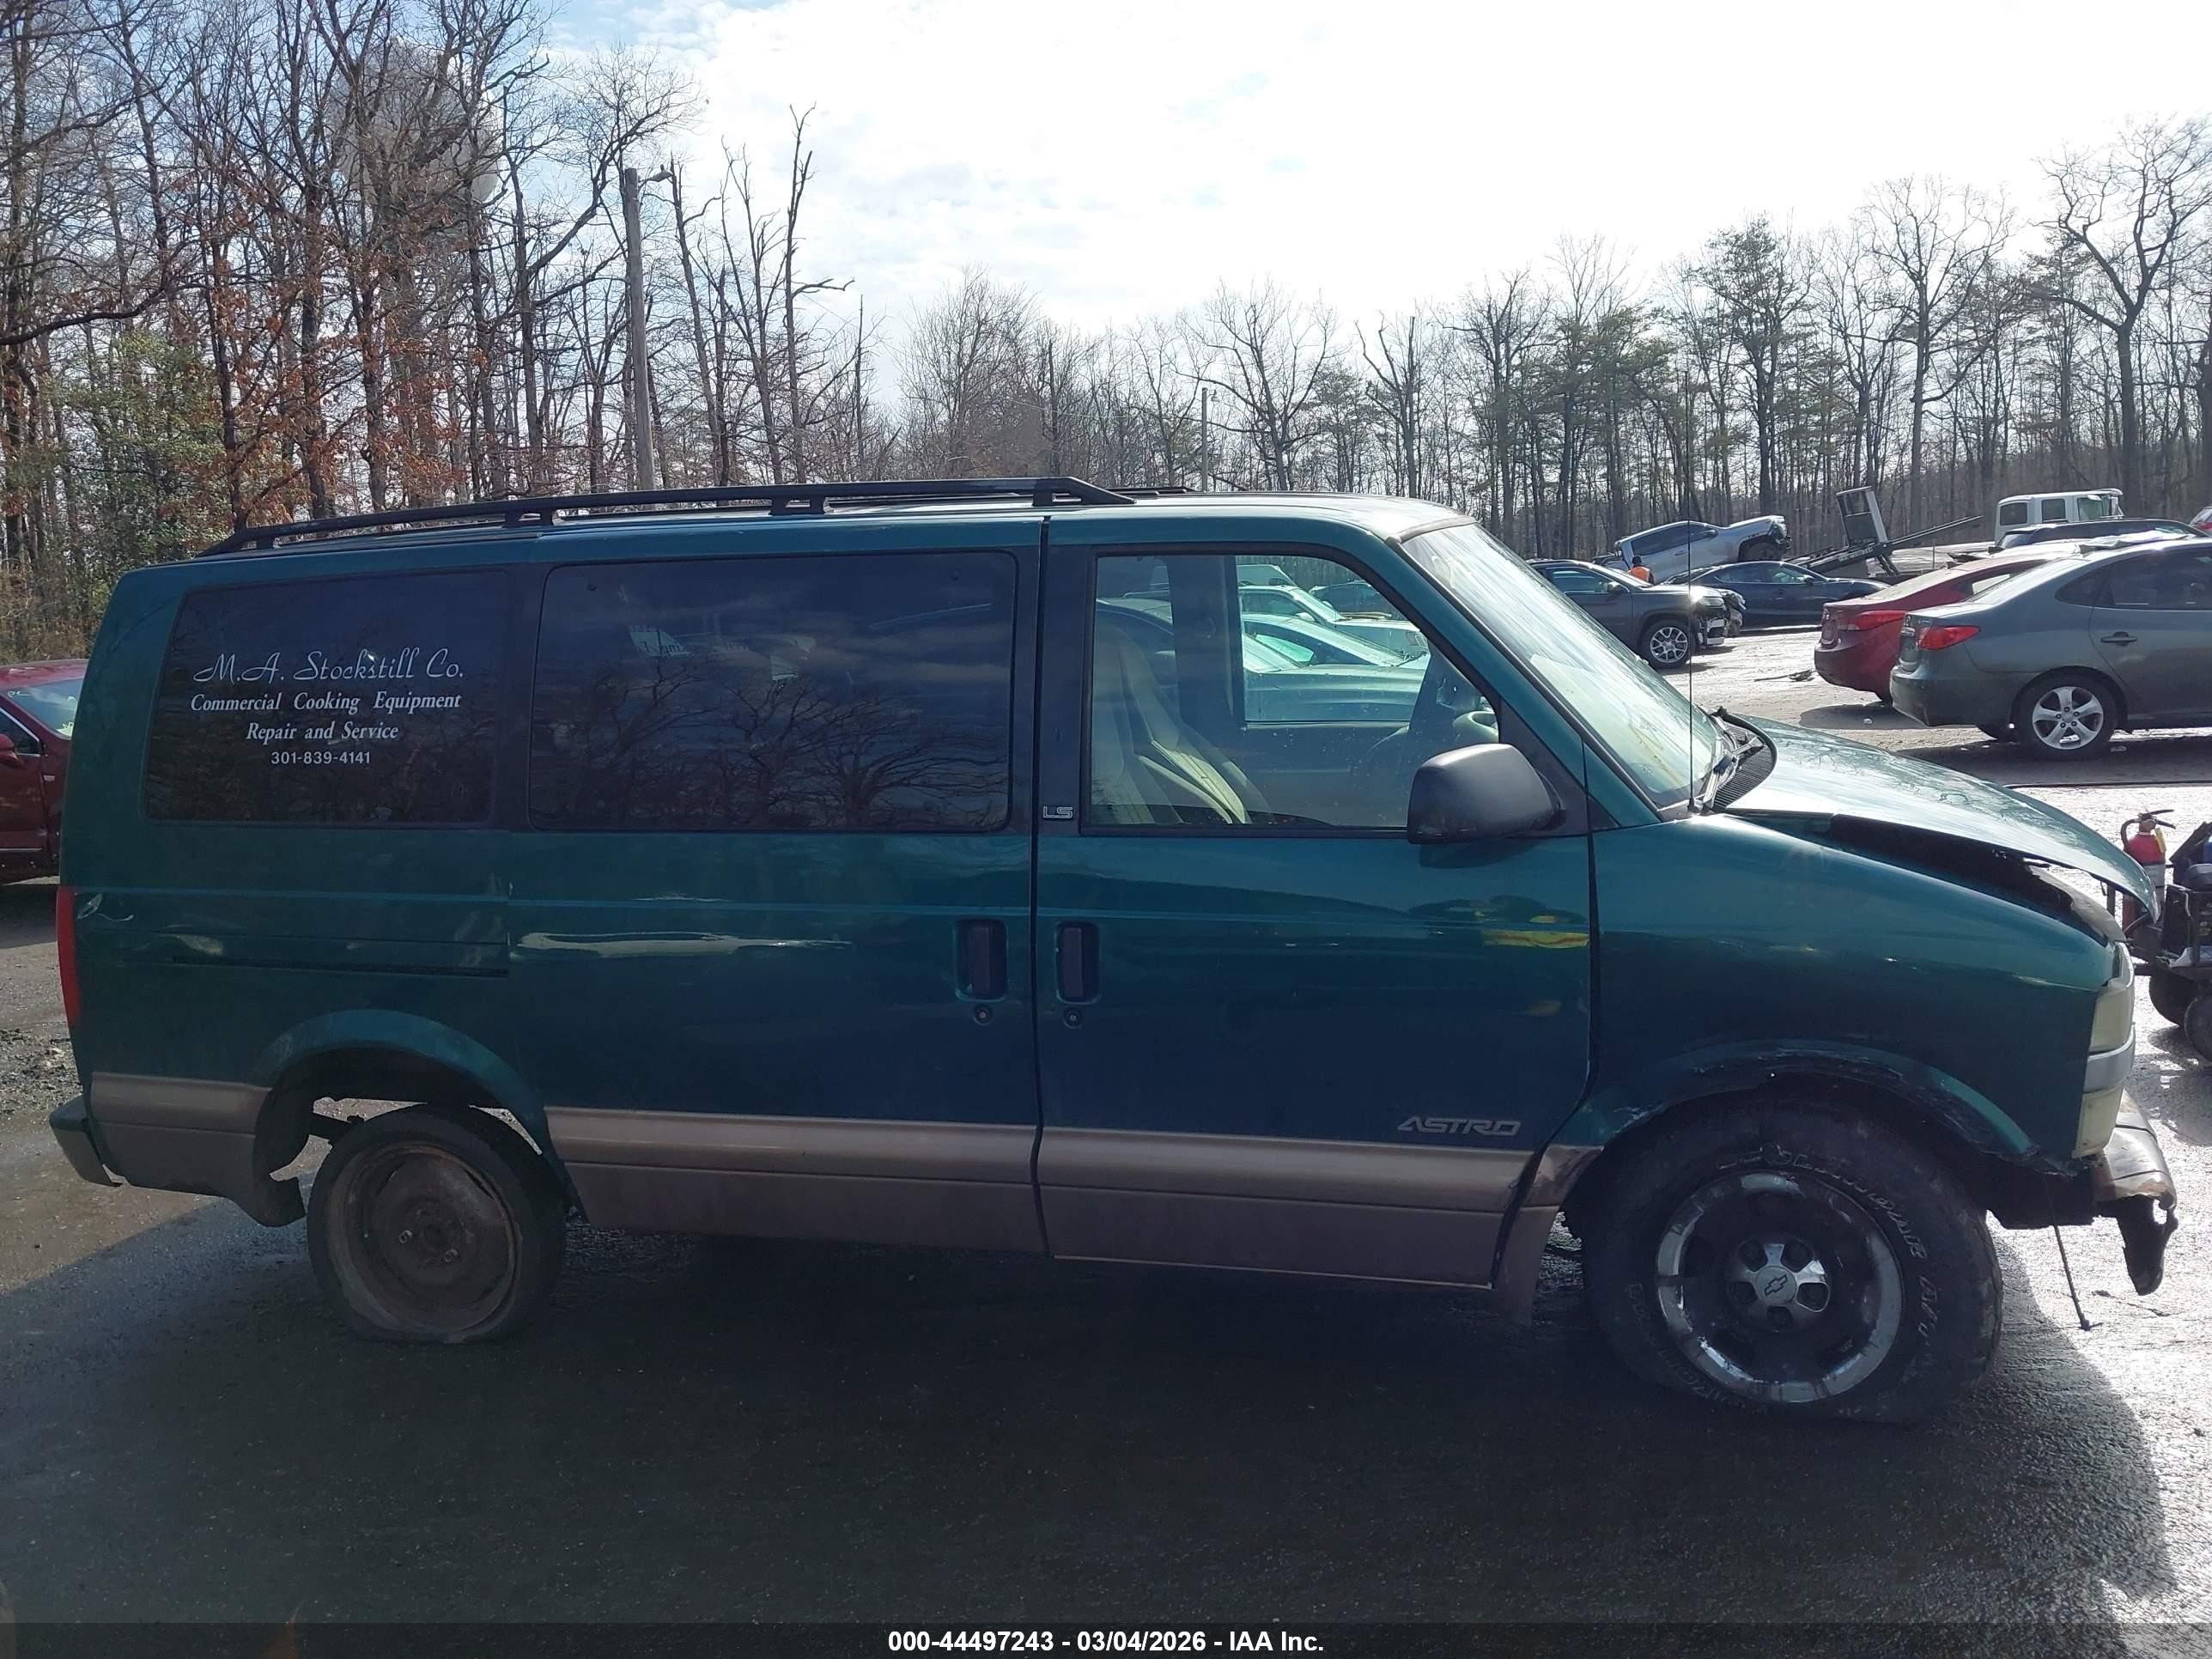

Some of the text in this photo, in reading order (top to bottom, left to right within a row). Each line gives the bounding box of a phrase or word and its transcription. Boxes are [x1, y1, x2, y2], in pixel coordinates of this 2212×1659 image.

[193, 647, 464, 684] M.A. Stockstill Co.
[191, 691, 463, 714] Commercial Cooking Equipment
[246, 721, 399, 745] Repair and Service
[271, 751, 371, 764] 301-839-4141
[1043, 806, 1073, 818] LS
[1397, 1116, 1521, 1136] ASTRO
